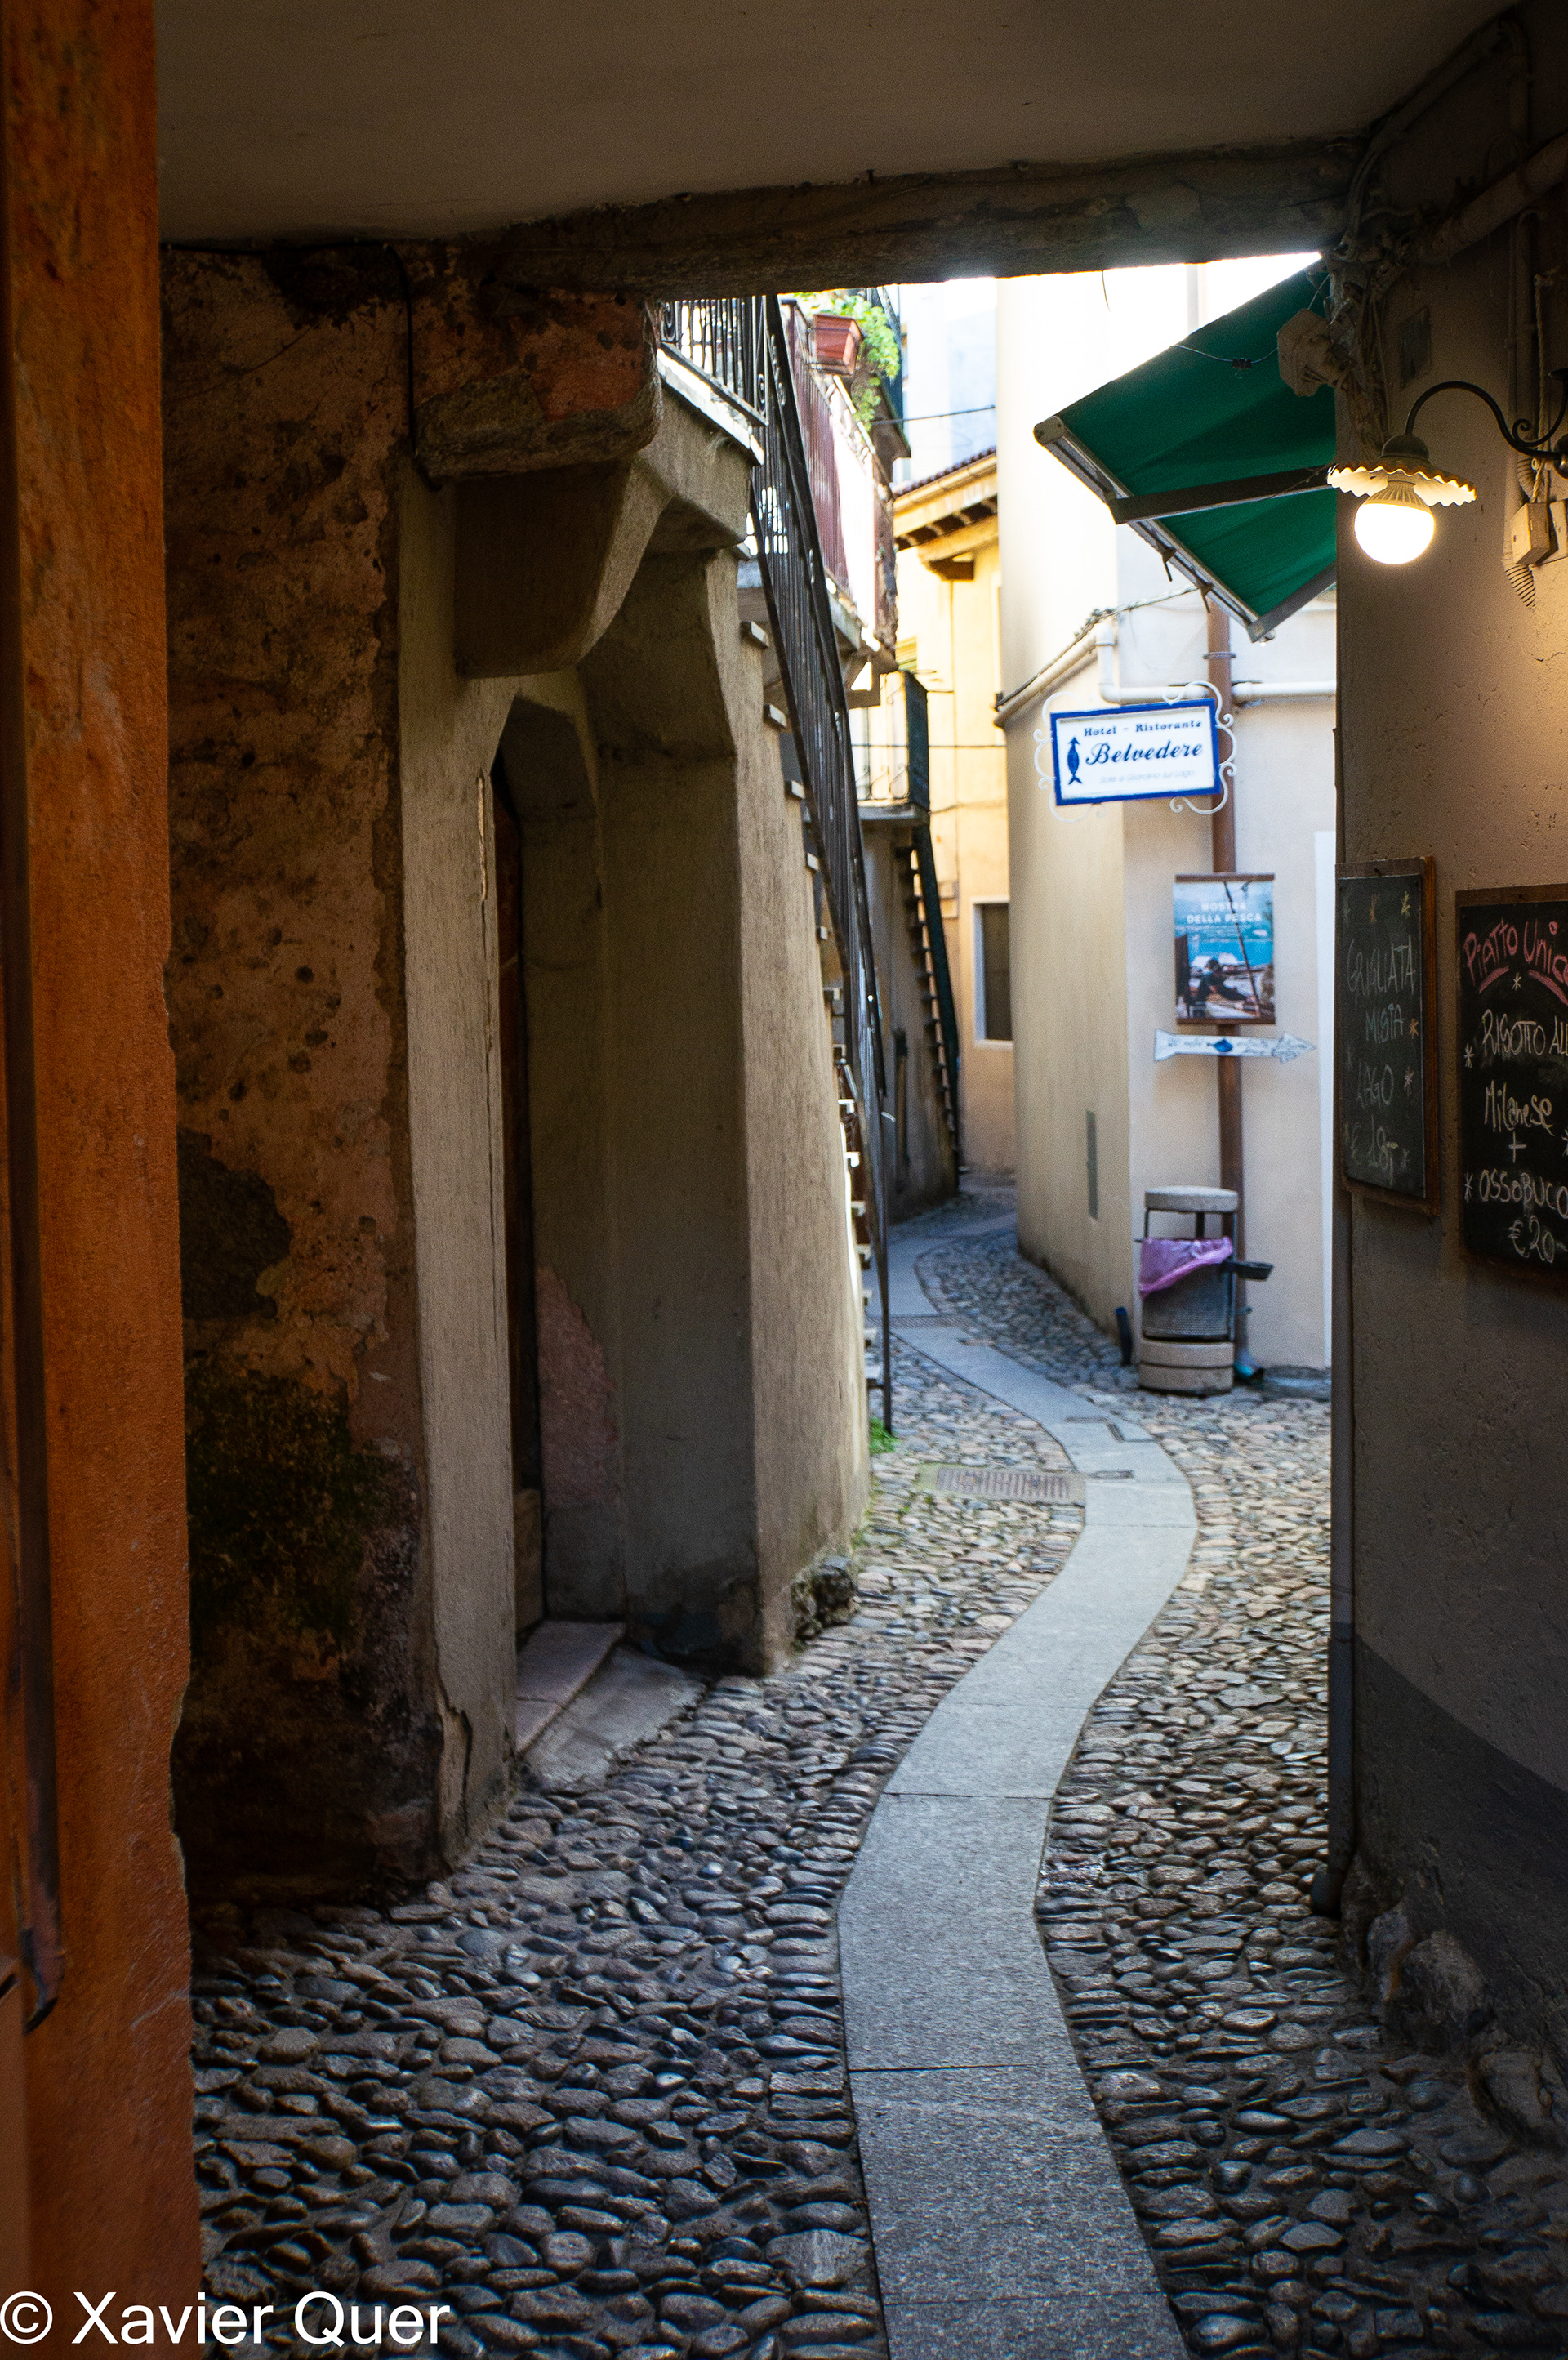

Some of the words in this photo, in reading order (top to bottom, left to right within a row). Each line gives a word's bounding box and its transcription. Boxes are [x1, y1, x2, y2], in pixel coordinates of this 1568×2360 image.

[1084, 725, 1117, 737] Hotel
[1136, 719, 1202, 734] Ristorante
[1085, 739, 1203, 765] Belvedere
[1200, 901, 1246, 912] MOSTRA
[1187, 914, 1221, 924] DELLA
[1225, 912, 1263, 923] PESCA
[1482, 1009, 1546, 1055] RISOTTO
